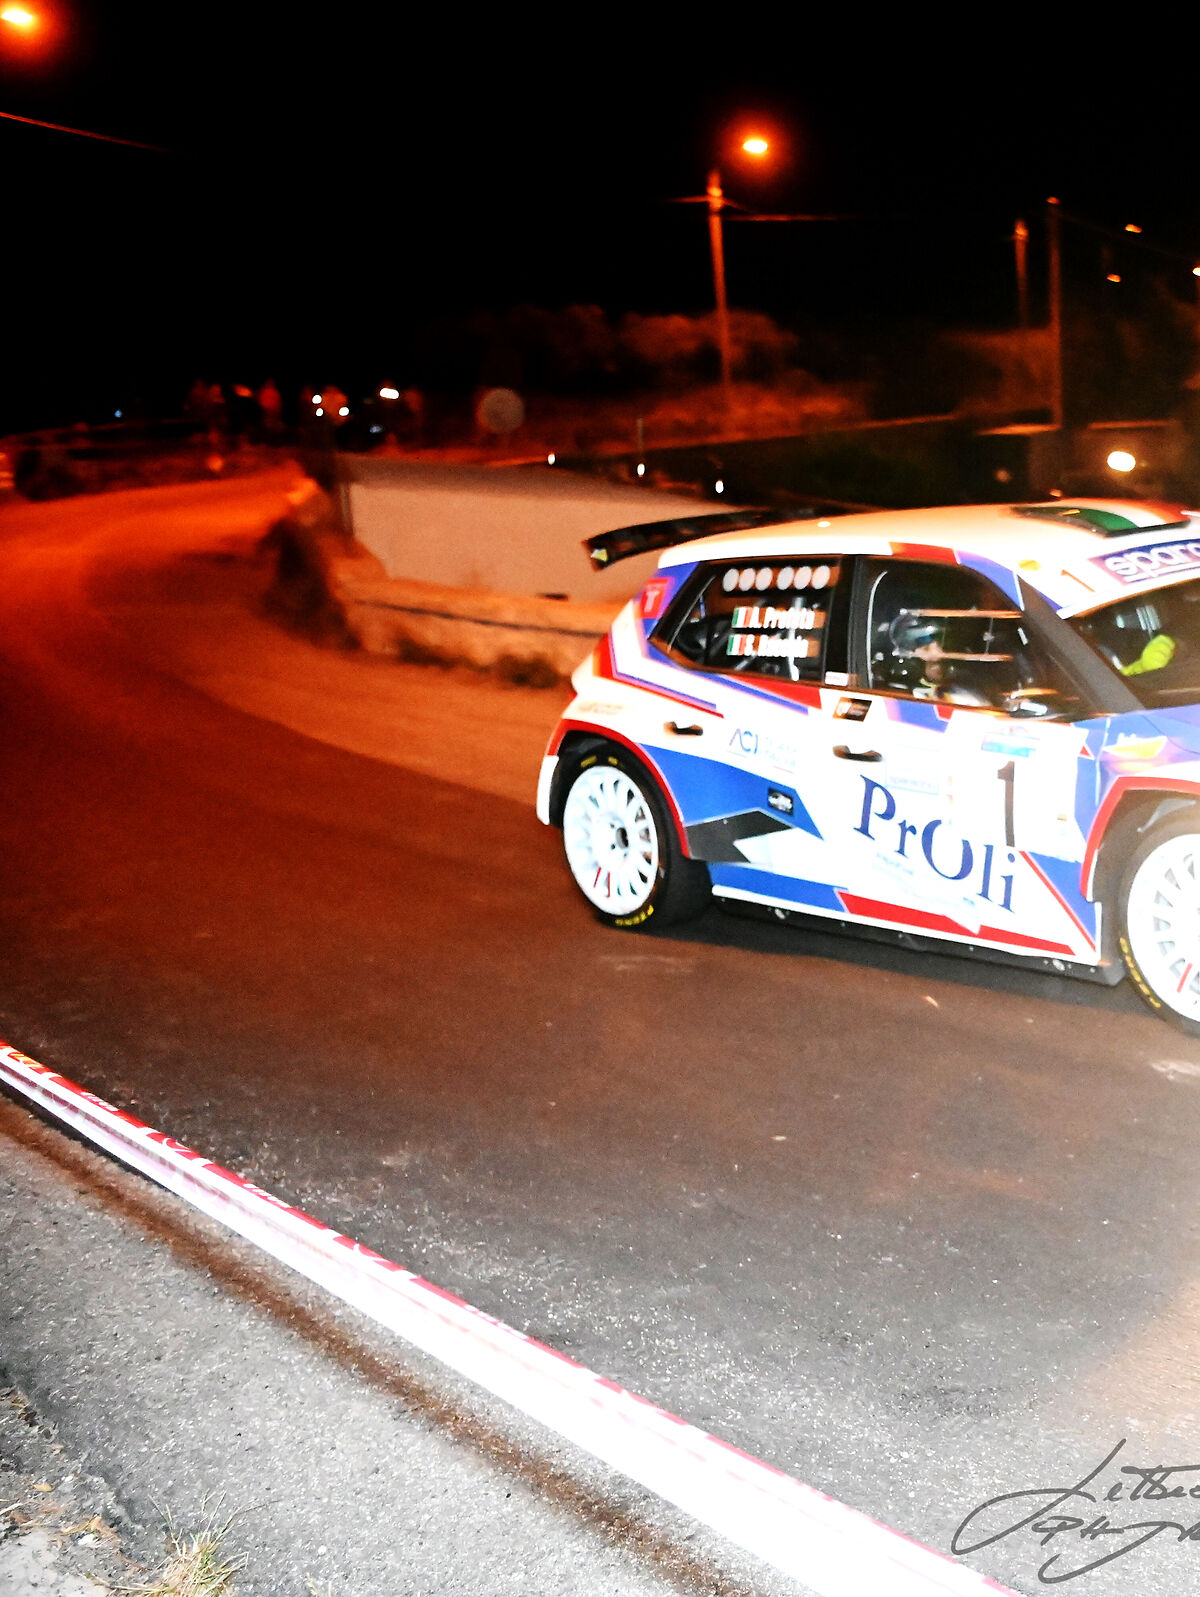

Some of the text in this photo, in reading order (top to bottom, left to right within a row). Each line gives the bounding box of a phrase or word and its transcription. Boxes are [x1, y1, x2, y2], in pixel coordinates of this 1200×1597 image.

[729, 728, 759, 755] ACI
[853, 774, 1015, 914] PrOli
[997, 761, 1015, 848] 1
